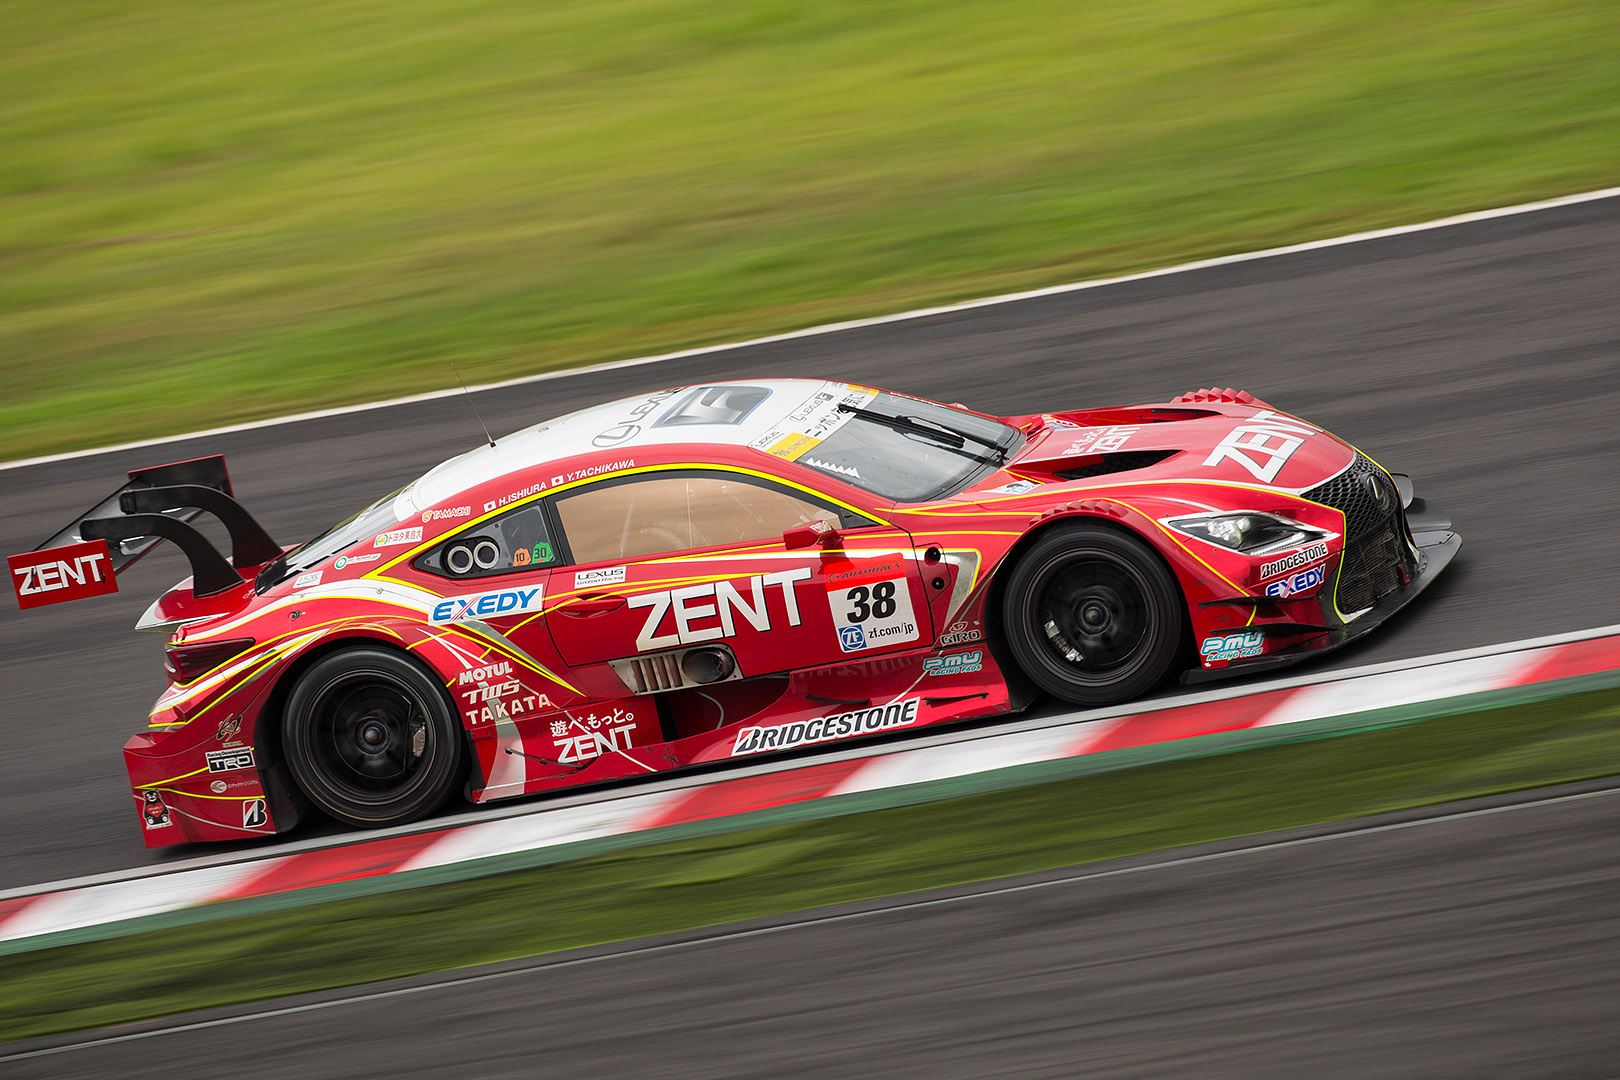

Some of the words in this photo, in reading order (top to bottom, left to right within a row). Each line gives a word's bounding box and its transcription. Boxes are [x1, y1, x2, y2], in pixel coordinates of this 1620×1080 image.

[1201, 410, 1325, 484] ZENT
[567, 459, 635, 481] Y.TACHIKAWA
[498, 481, 547, 507] H.ISHIURA
[432, 506, 471, 520] TAMACHI
[388, 530, 422, 543] トヨタ東自大
[515, 552, 525, 563] 10
[534, 547, 547, 560] 30
[1261, 543, 1328, 580] BRIDGESTONE
[14, 553, 104, 596] ZENT
[577, 568, 624, 580] LEXUS
[841, 563, 901, 579] AUTOBACS
[1266, 564, 1326, 598] EXEDY
[432, 588, 540, 622] EXEDY
[627, 567, 812, 652] ZENT
[846, 581, 896, 624] 38
[843, 631, 863, 646] ZF
[868, 622, 915, 639] zf.com/jp
[940, 630, 981, 645] GIRO
[1206, 652, 1239, 661] RACING
[1239, 647, 1263, 658] PADS
[459, 661, 513, 686] MOTUL
[930, 667, 960, 676] RACING
[961, 664, 982, 673] PADS
[466, 694, 551, 725] TAKATA
[731, 697, 920, 756] BRIDGESTONE
[553, 723, 637, 763] ZENT
[210, 756, 251, 770] TRD
